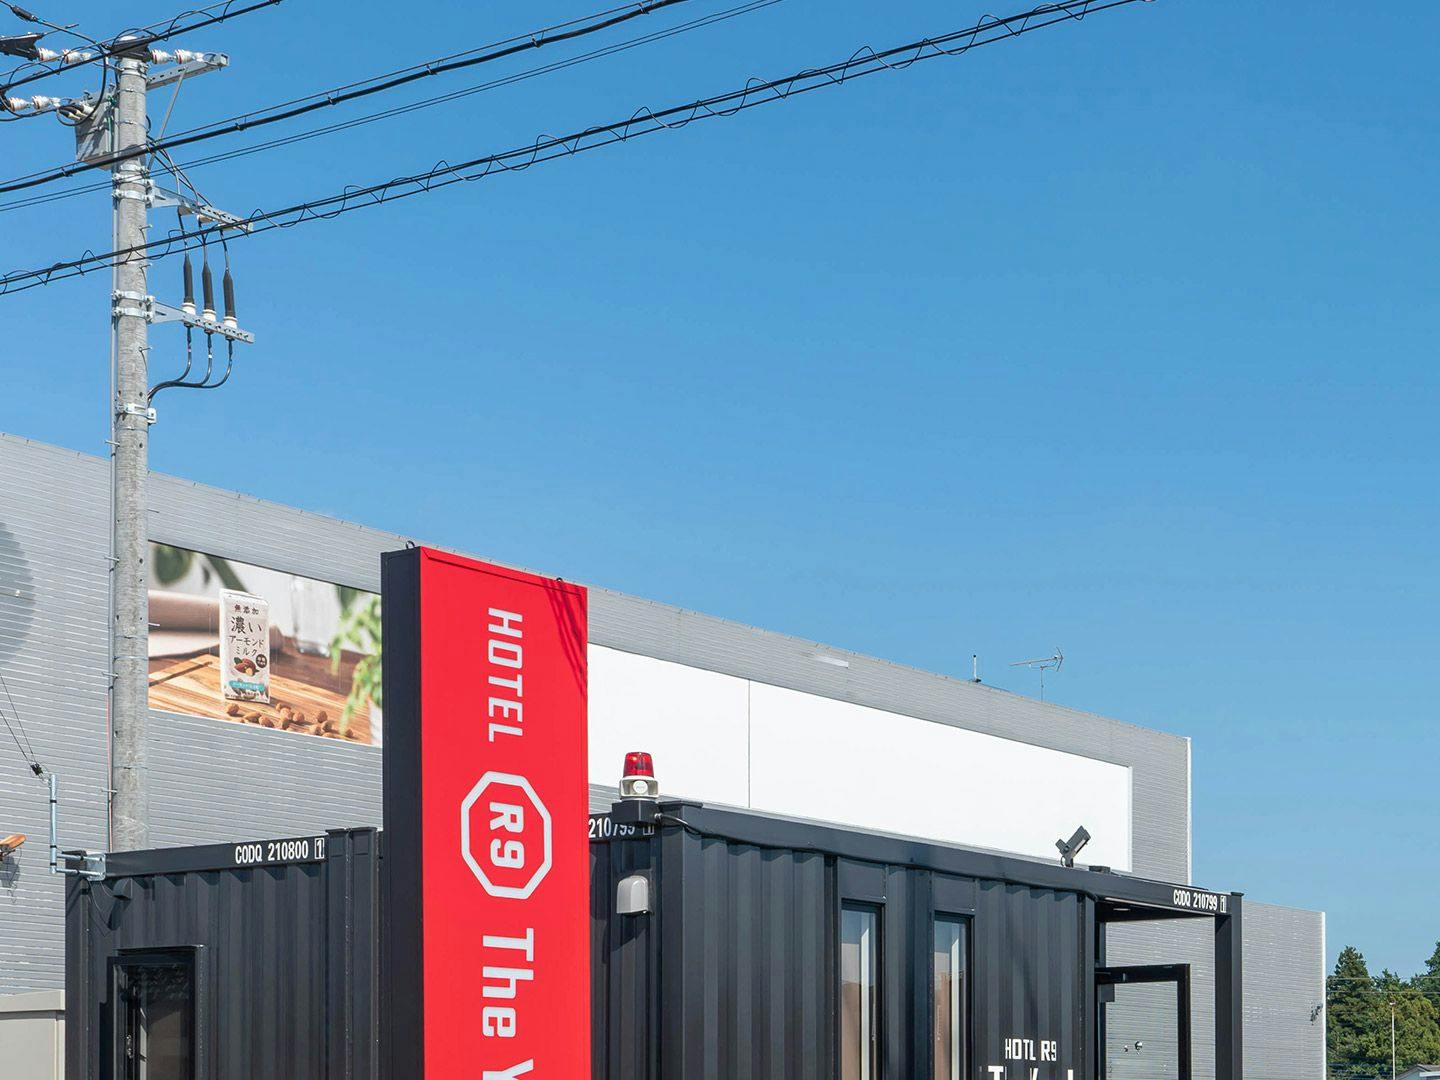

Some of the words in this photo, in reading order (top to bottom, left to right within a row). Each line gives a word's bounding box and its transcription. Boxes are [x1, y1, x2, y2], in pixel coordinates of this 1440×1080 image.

[230, 616, 262, 635] 濃い
[228, 635, 265, 649] アーモンド
[235, 646, 258, 657] ミルク
[488, 606, 524, 743] HOTEL
[489, 801, 526, 870] R9
[267, 840, 309, 861] 210800
[1193, 892, 1218, 911] 210799
[482, 927, 535, 1038] The
[1005, 1038, 1037, 1060] HOTL
